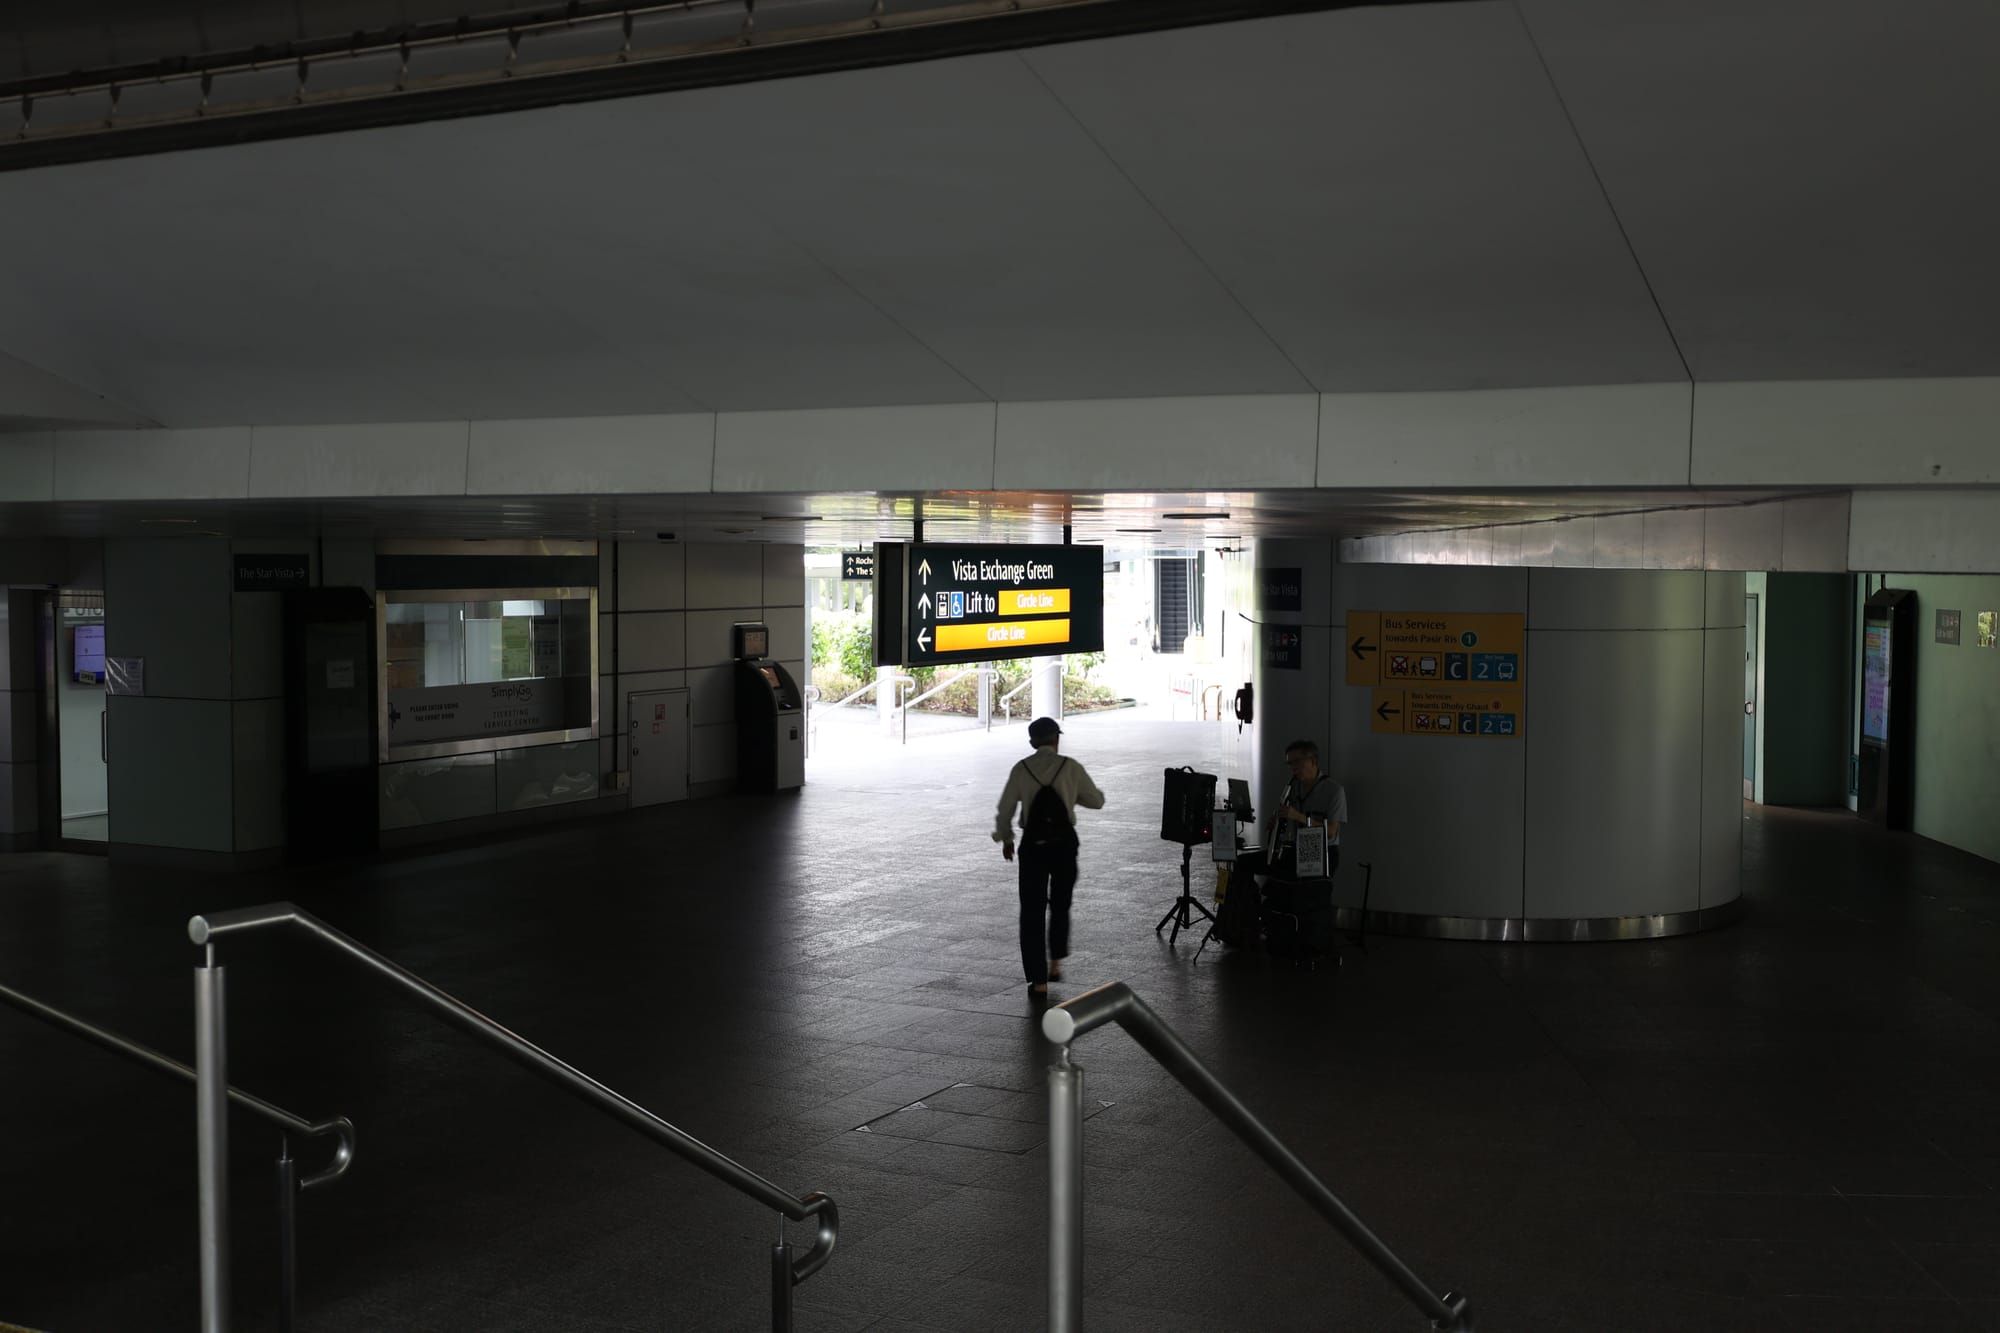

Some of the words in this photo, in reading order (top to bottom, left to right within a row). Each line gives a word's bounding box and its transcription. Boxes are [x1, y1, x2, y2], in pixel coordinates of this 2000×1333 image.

[240, 567, 254, 578] The
[256, 567, 273, 578] Star
[274, 567, 295, 578] Vista
[856, 567, 868, 576] The
[952, 559, 978, 581] Vista
[980, 559, 1025, 585] Exchange
[1026, 560, 1054, 580] Green
[966, 591, 983, 614] Lift
[984, 594, 996, 613] to
[1017, 593, 1038, 609] Circle
[1039, 594, 1054, 608] Line
[1385, 619, 1402, 629] Bus
[1405, 619, 1447, 630] Services
[987, 627, 1008, 641] Circle
[1009, 626, 1025, 640] Line
[1385, 633, 1418, 643] towards
[1420, 634, 1441, 644] Pasir
[1444, 635, 1458, 644] Ris
[1450, 661, 1463, 679] C
[1477, 662, 1489, 679] 2
[491, 684, 533, 701] SimplyGo
[1441, 703, 1465, 711] Dhoby
[1463, 719, 1472, 733] C
[1484, 720, 1493, 733] 2
